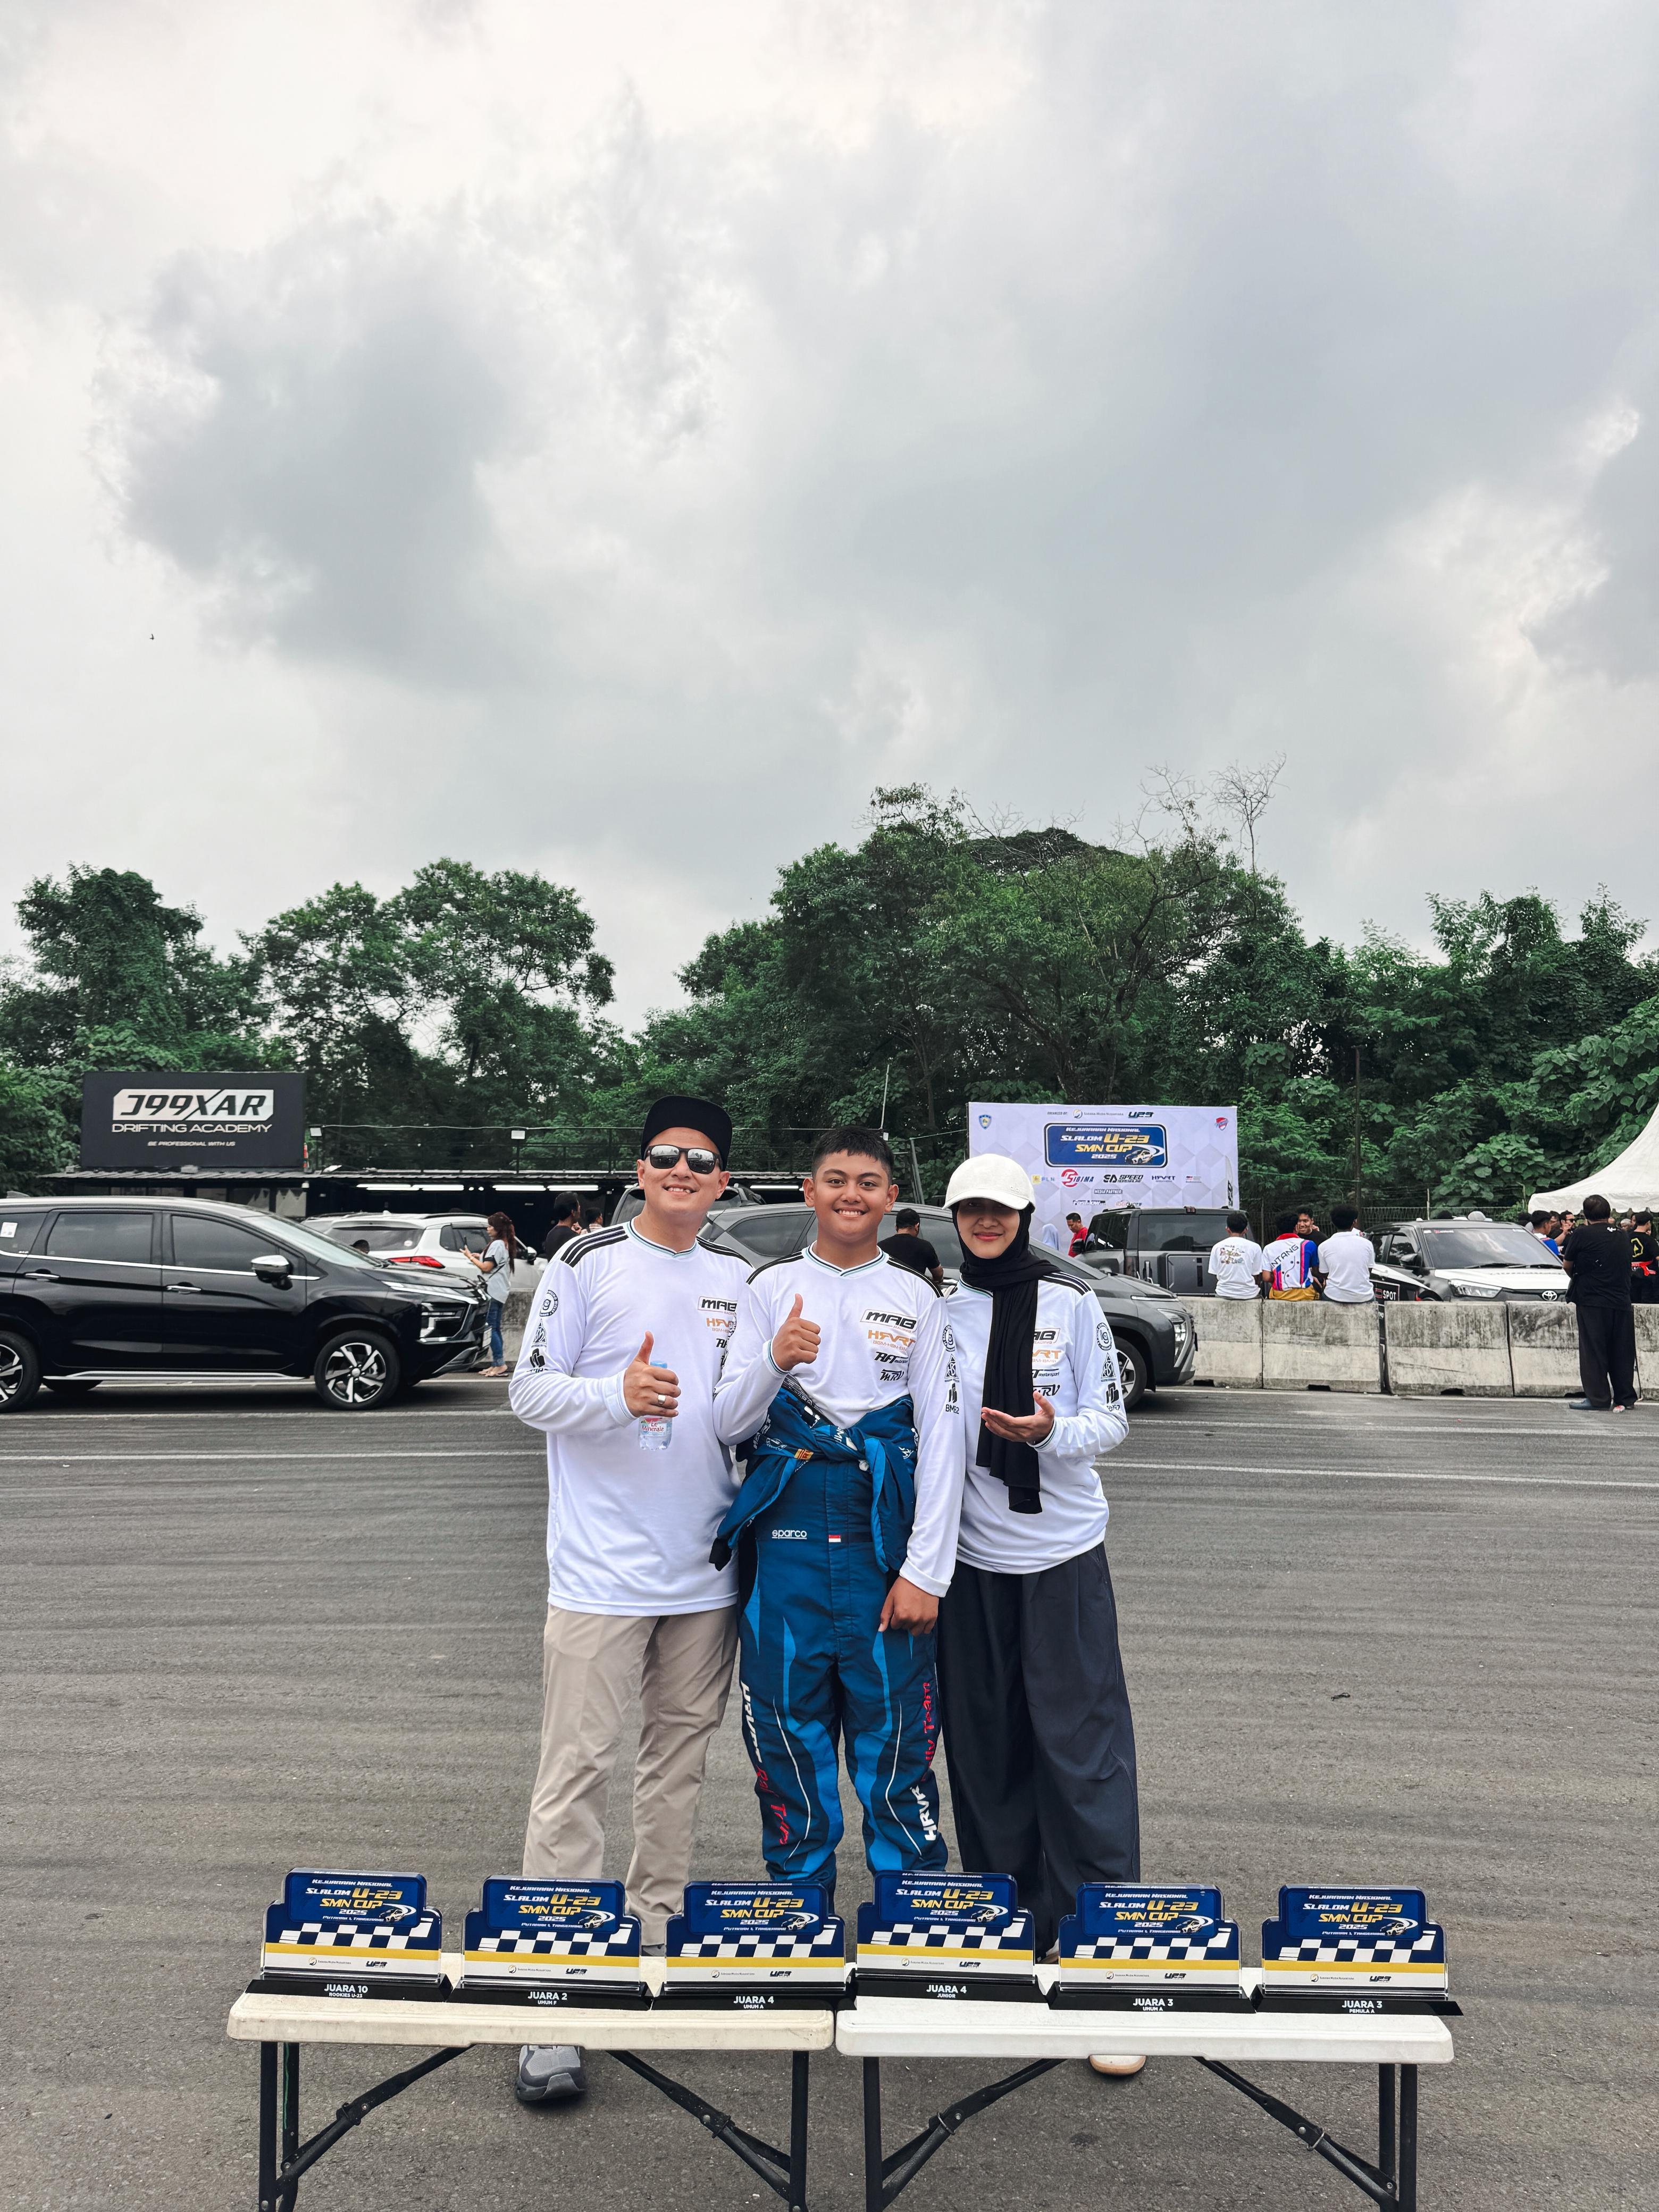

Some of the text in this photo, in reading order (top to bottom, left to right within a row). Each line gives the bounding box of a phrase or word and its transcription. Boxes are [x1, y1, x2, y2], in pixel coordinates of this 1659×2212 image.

[112, 1124, 273, 1133] DRIFTING ACADEMY
[1103, 1134, 1150, 1143] U-23
[1383, 1290, 1396, 1300] SPOT
[772, 1530, 807, 1539] sparco
[352, 1888, 403, 1899] U-23
[943, 1889, 994, 1900] U-23
[320, 1898, 383, 1908] SMN CUP
[550, 1894, 601, 1906] U-23
[752, 1898, 804, 1907] U-23
[910, 1899, 974, 1909] SMN CUP
[518, 1905, 581, 1915] SMN CUP
[1146, 1900, 1199, 1911] U-23
[1351, 1902, 1403, 1913] U-23
[720, 1909, 784, 1918] SMN CUP
[1149, 1912, 1179, 1921] CUP
[1318, 1914, 1383, 1923] SMN CUP
[324, 1984, 355, 1992] JUARA
[527, 1991, 559, 2000] JUARA
